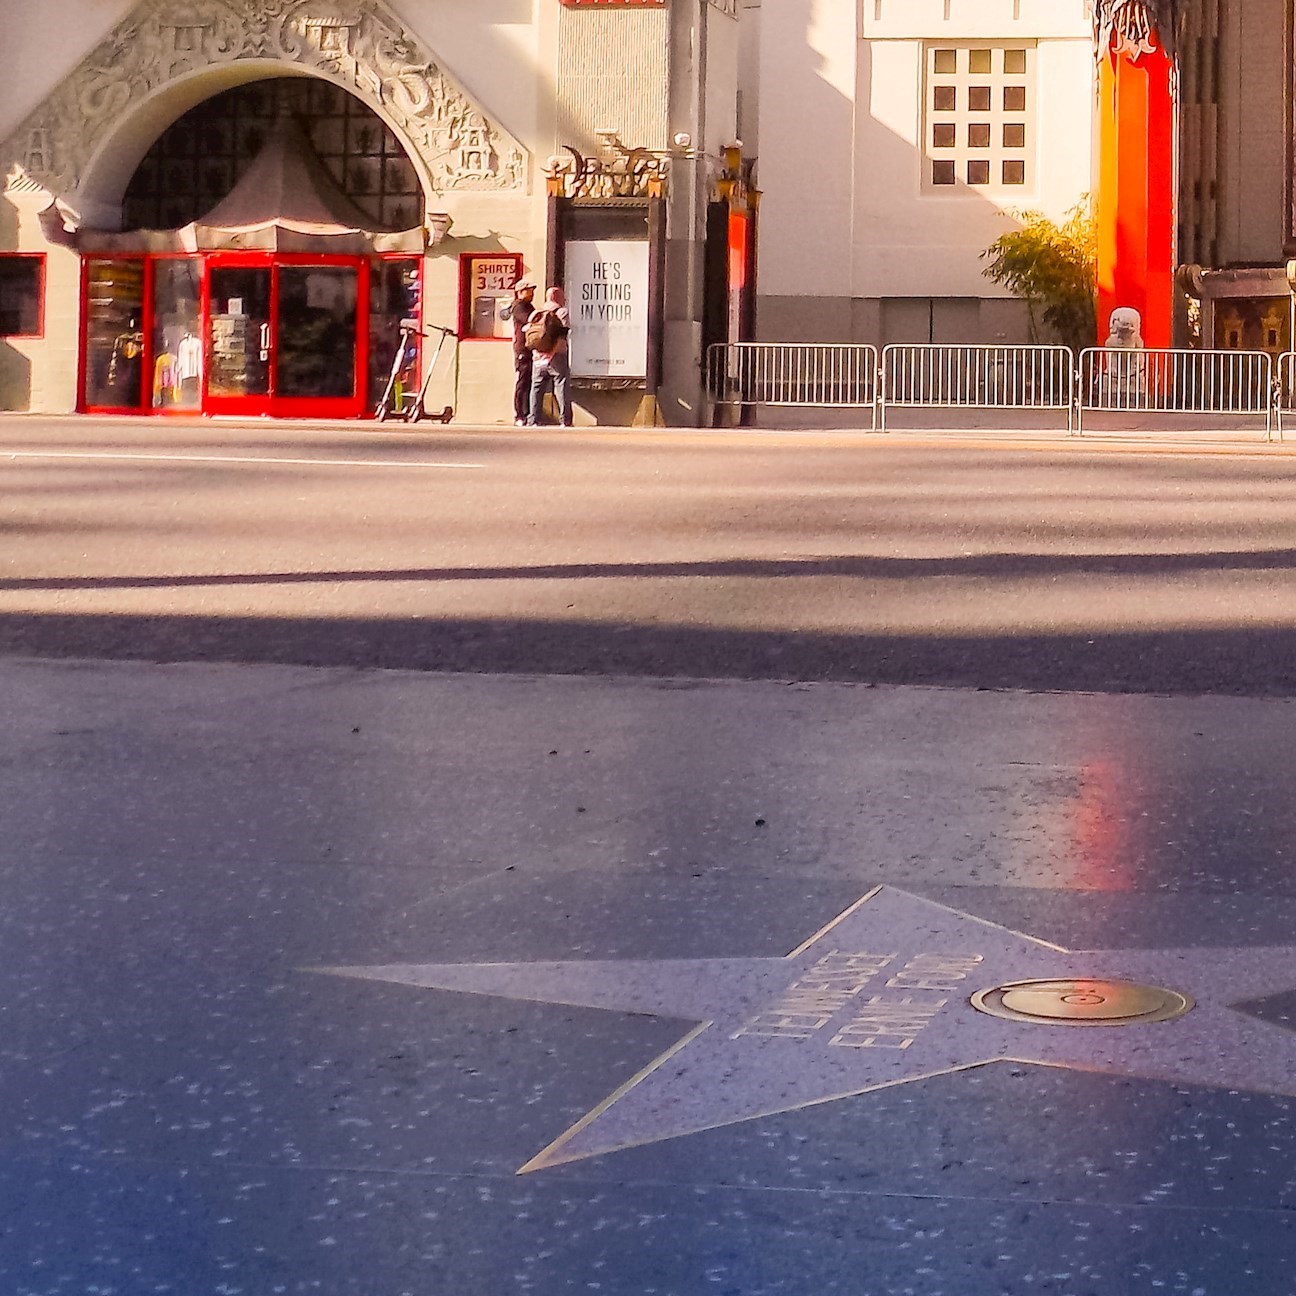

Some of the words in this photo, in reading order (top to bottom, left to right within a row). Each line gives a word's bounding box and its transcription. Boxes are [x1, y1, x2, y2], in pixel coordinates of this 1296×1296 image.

[478, 264, 515, 274] SHIRTS
[593, 262, 621, 280] HE'S
[477, 276, 486, 290] 3
[582, 283, 631, 301] SITTING
[580, 304, 594, 321] IN
[598, 304, 632, 322] YOUR
